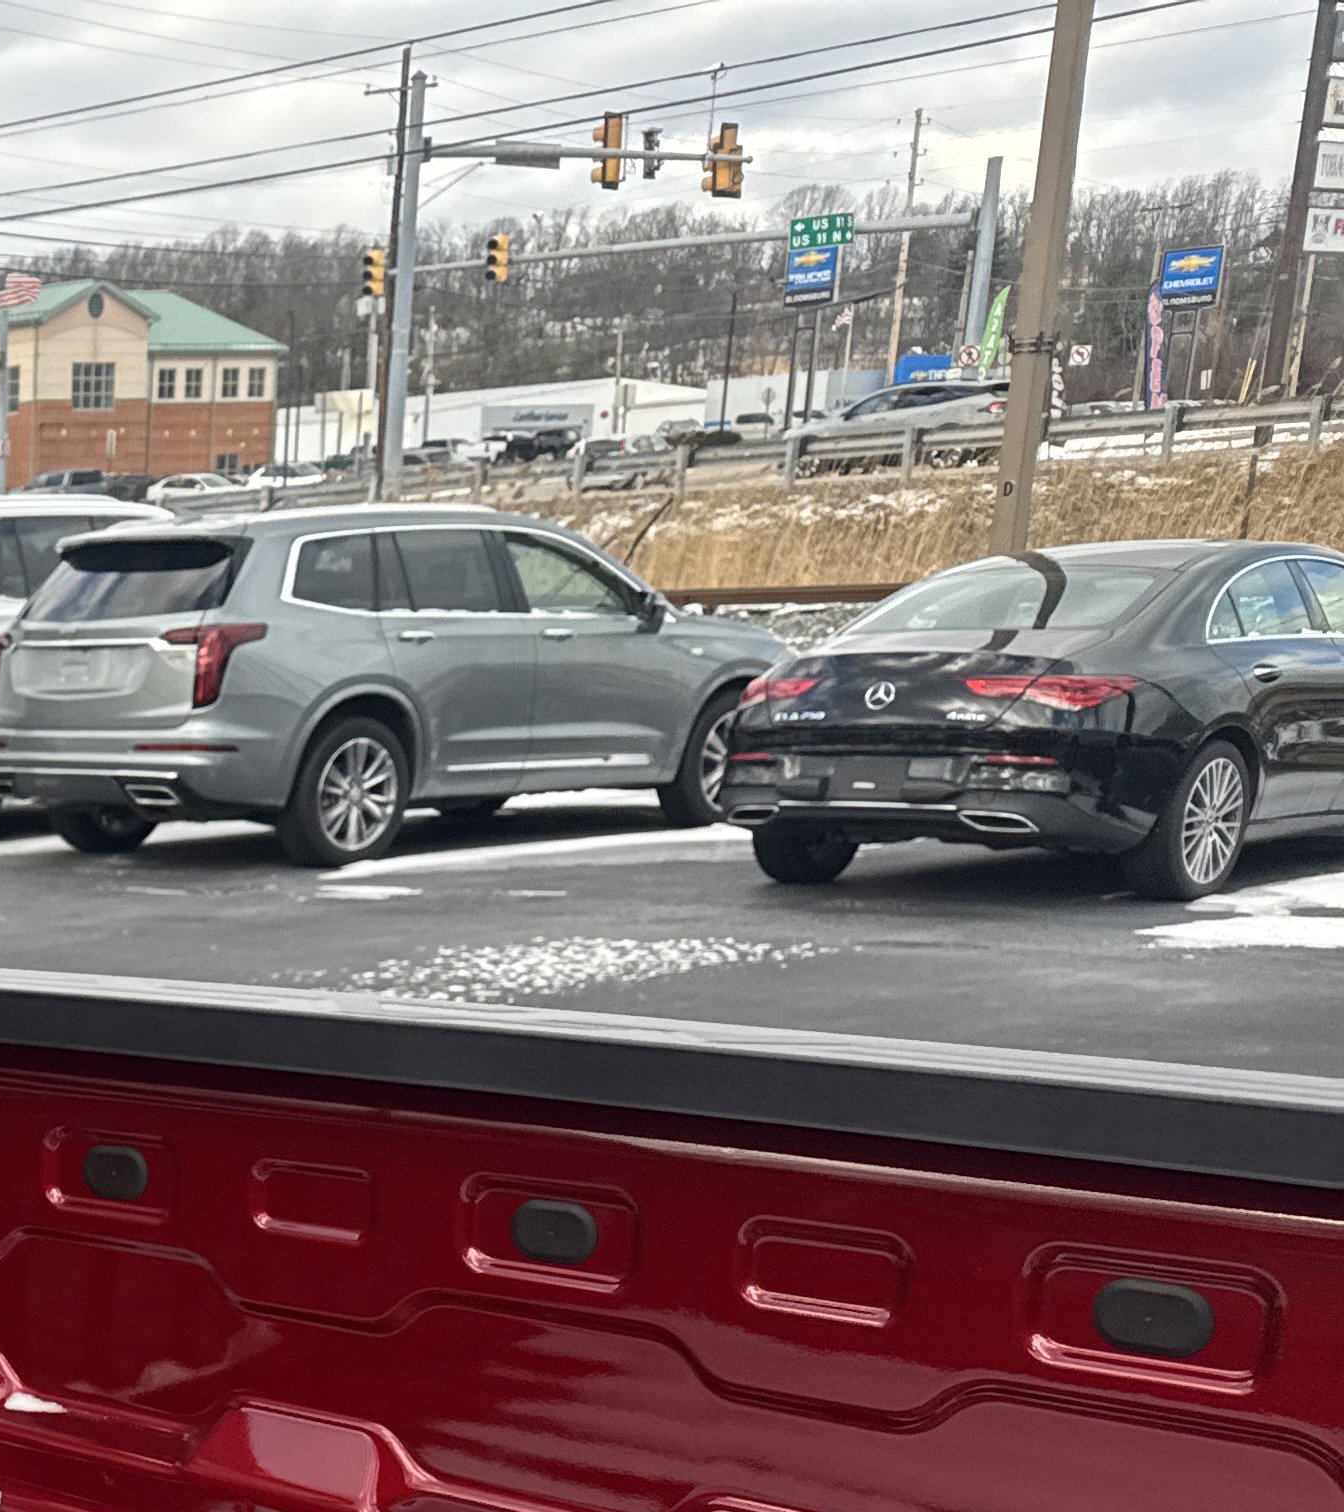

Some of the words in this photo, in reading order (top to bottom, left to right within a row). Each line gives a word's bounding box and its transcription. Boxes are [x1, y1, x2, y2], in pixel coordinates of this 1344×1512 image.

[813, 218, 829, 230] US
[836, 216, 844, 228] 11
[792, 234, 810, 247] US
[816, 232, 827, 244] 11
[832, 231, 842, 243] N
[1163, 276, 1215, 289] CHEVROLET
[1003, 481, 1014, 497] D
